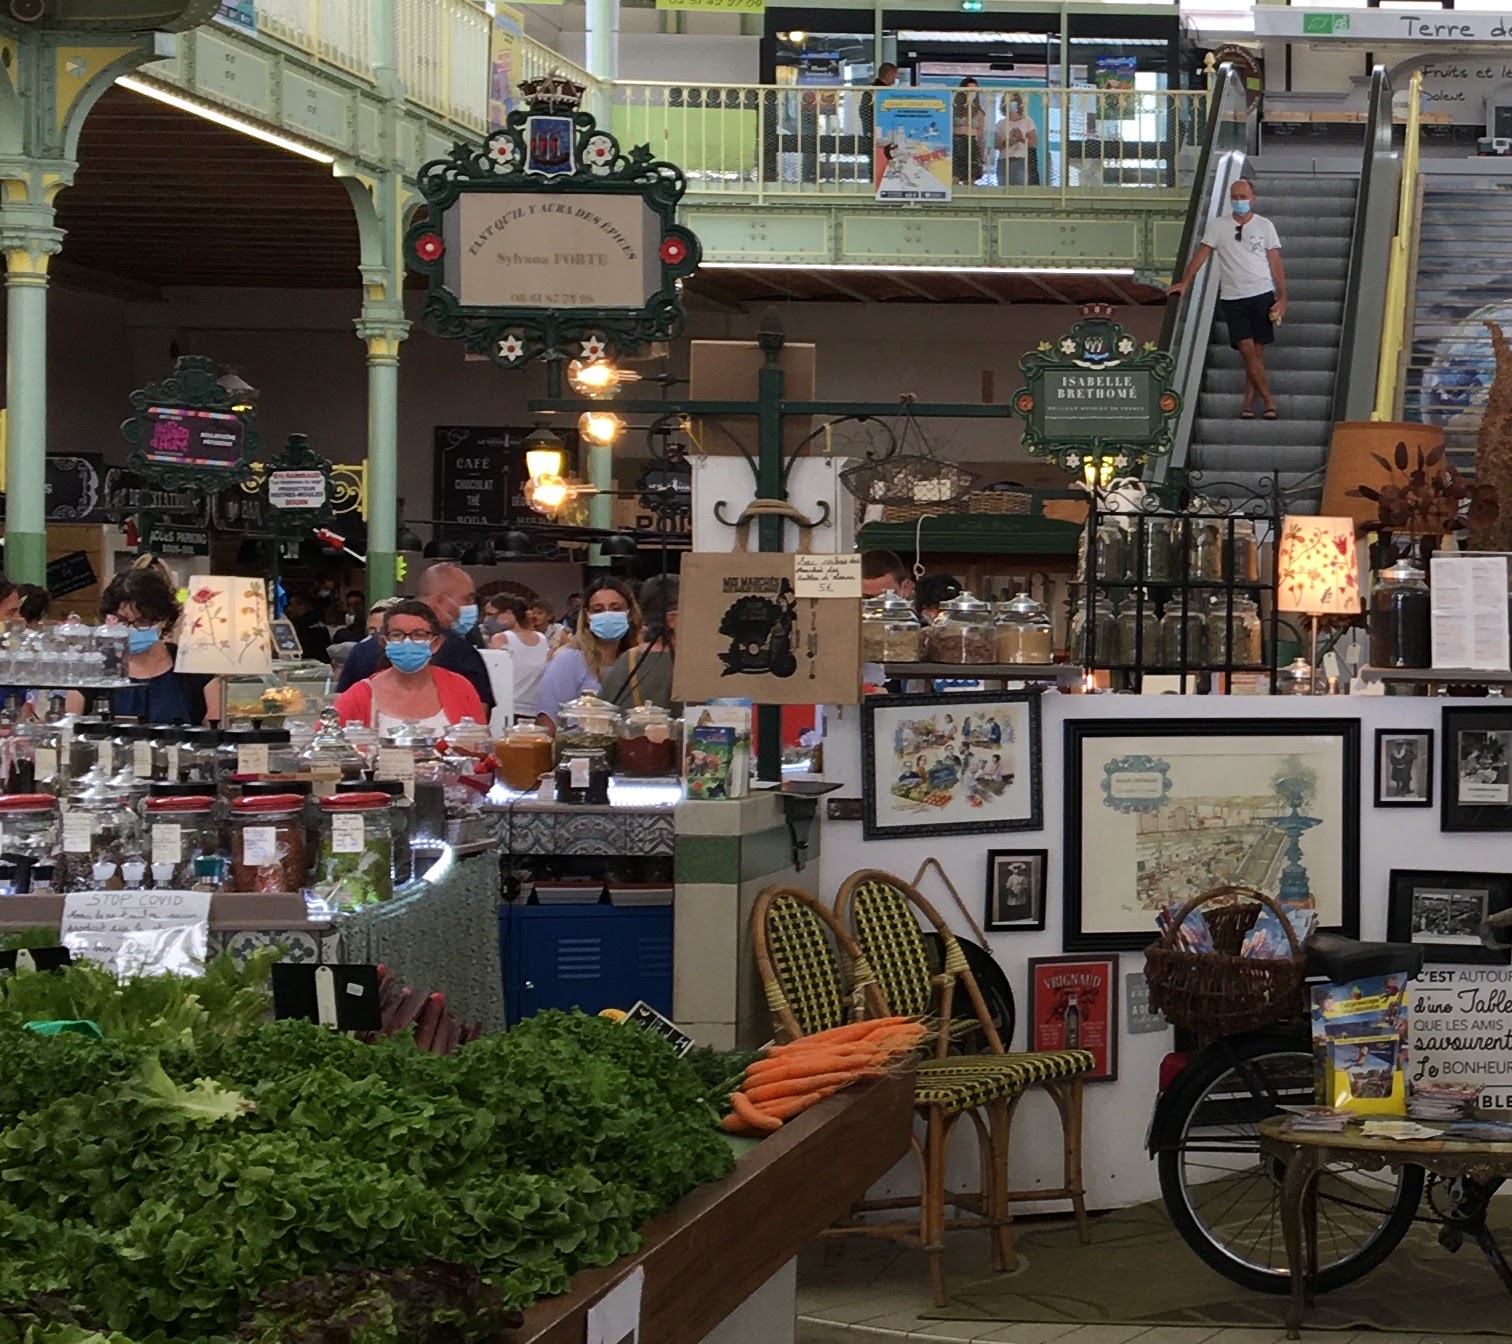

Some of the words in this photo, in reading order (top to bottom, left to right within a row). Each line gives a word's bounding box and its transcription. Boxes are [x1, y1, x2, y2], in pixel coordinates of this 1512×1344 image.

[1400, 15, 1475, 39] Terre
[1421, 64, 1469, 81] Fruits
[1475, 65, 1495, 80] et
[527, 205, 537, 215] Y
[540, 203, 573, 215] AURA
[574, 208, 602, 225] DES
[497, 252, 550, 267] Sylvana
[553, 253, 608, 266] FORTE
[1062, 376, 1133, 387] ISABELLE
[1057, 386, 1138, 399] BRETHOMÉ
[456, 457, 491, 470] CAFÉ
[454, 479, 494, 490] CHOCOLAT
[466, 493, 480, 507] THÉ
[86, 893, 133, 906] STOP
[138, 894, 185, 906] COVID
[1043, 972, 1103, 990] VRIGNAUD
[1415, 971, 1456, 983] C'EST
[1414, 996, 1454, 1014] d'une
[1413, 1019, 1442, 1032] QUE
[1445, 1019, 1468, 1032] LES
[1470, 1019, 1504, 1032] AMIS
[1413, 1055, 1440, 1082] Le
